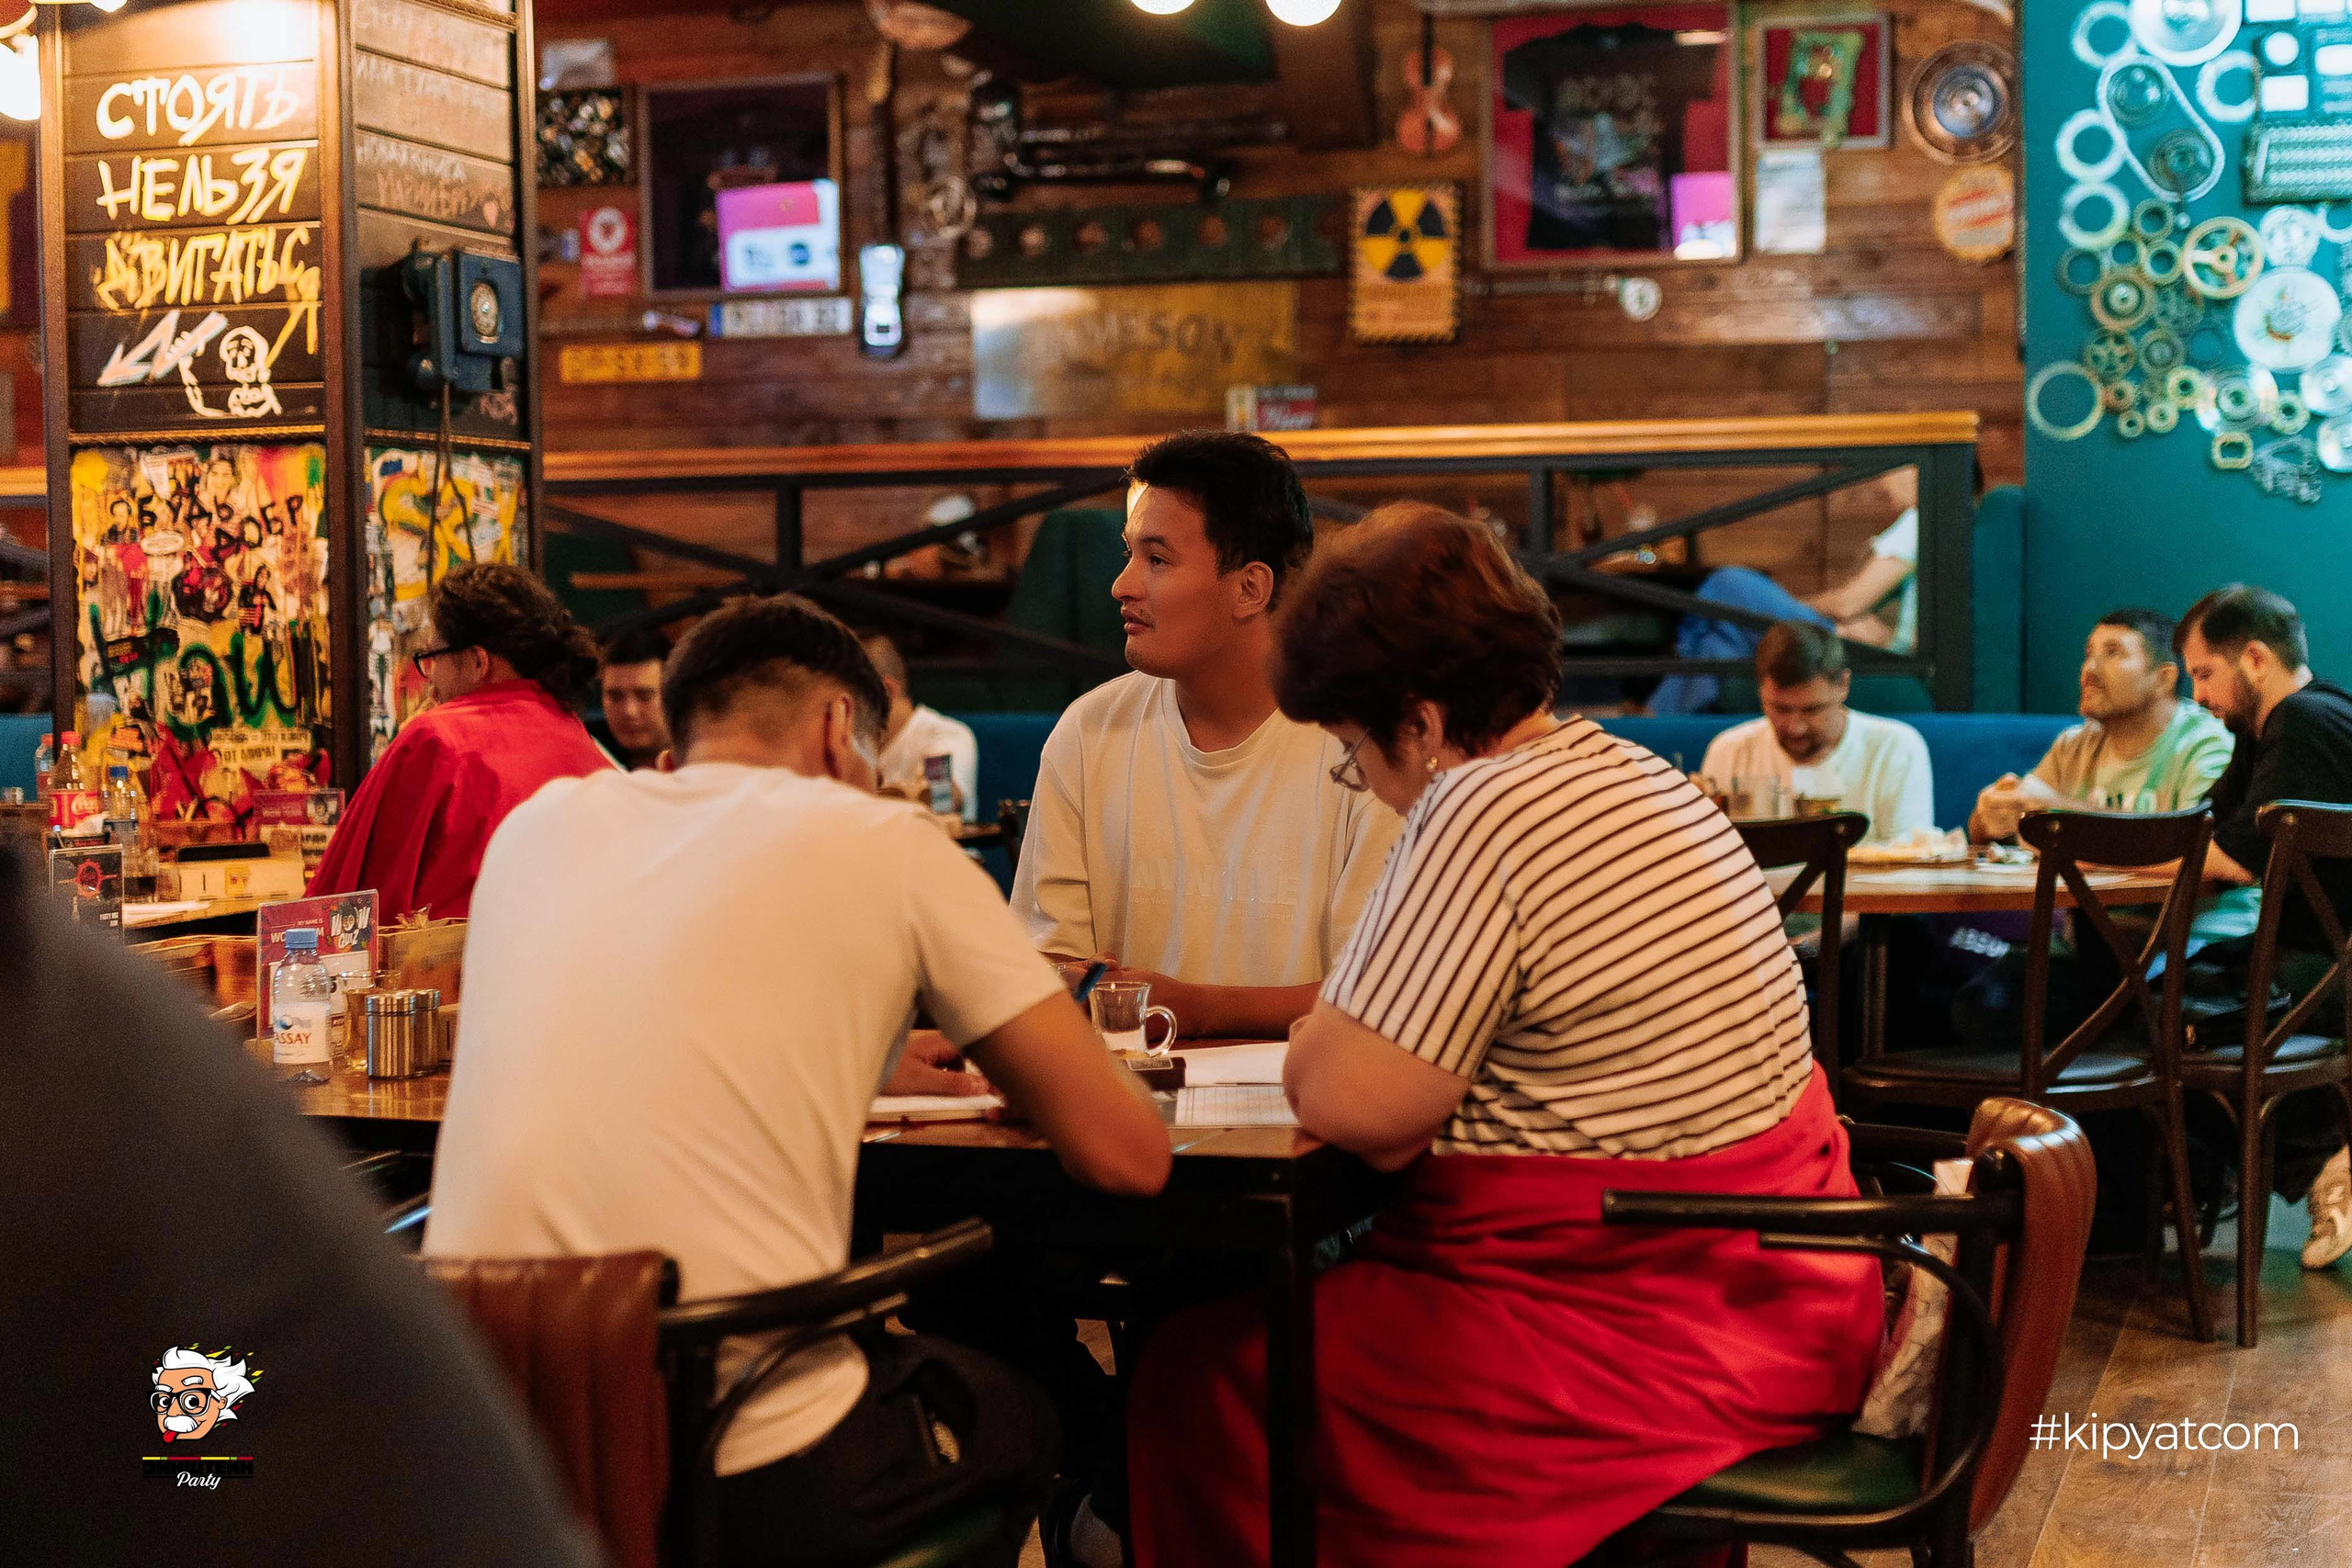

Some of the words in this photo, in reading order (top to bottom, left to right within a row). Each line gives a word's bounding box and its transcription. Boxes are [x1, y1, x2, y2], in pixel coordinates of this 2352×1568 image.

[96, 69, 300, 146] СТОЯТЬ
[96, 147, 309, 224] НЕЛЬЗЯ
[337, 929, 360, 950] QUIZ
